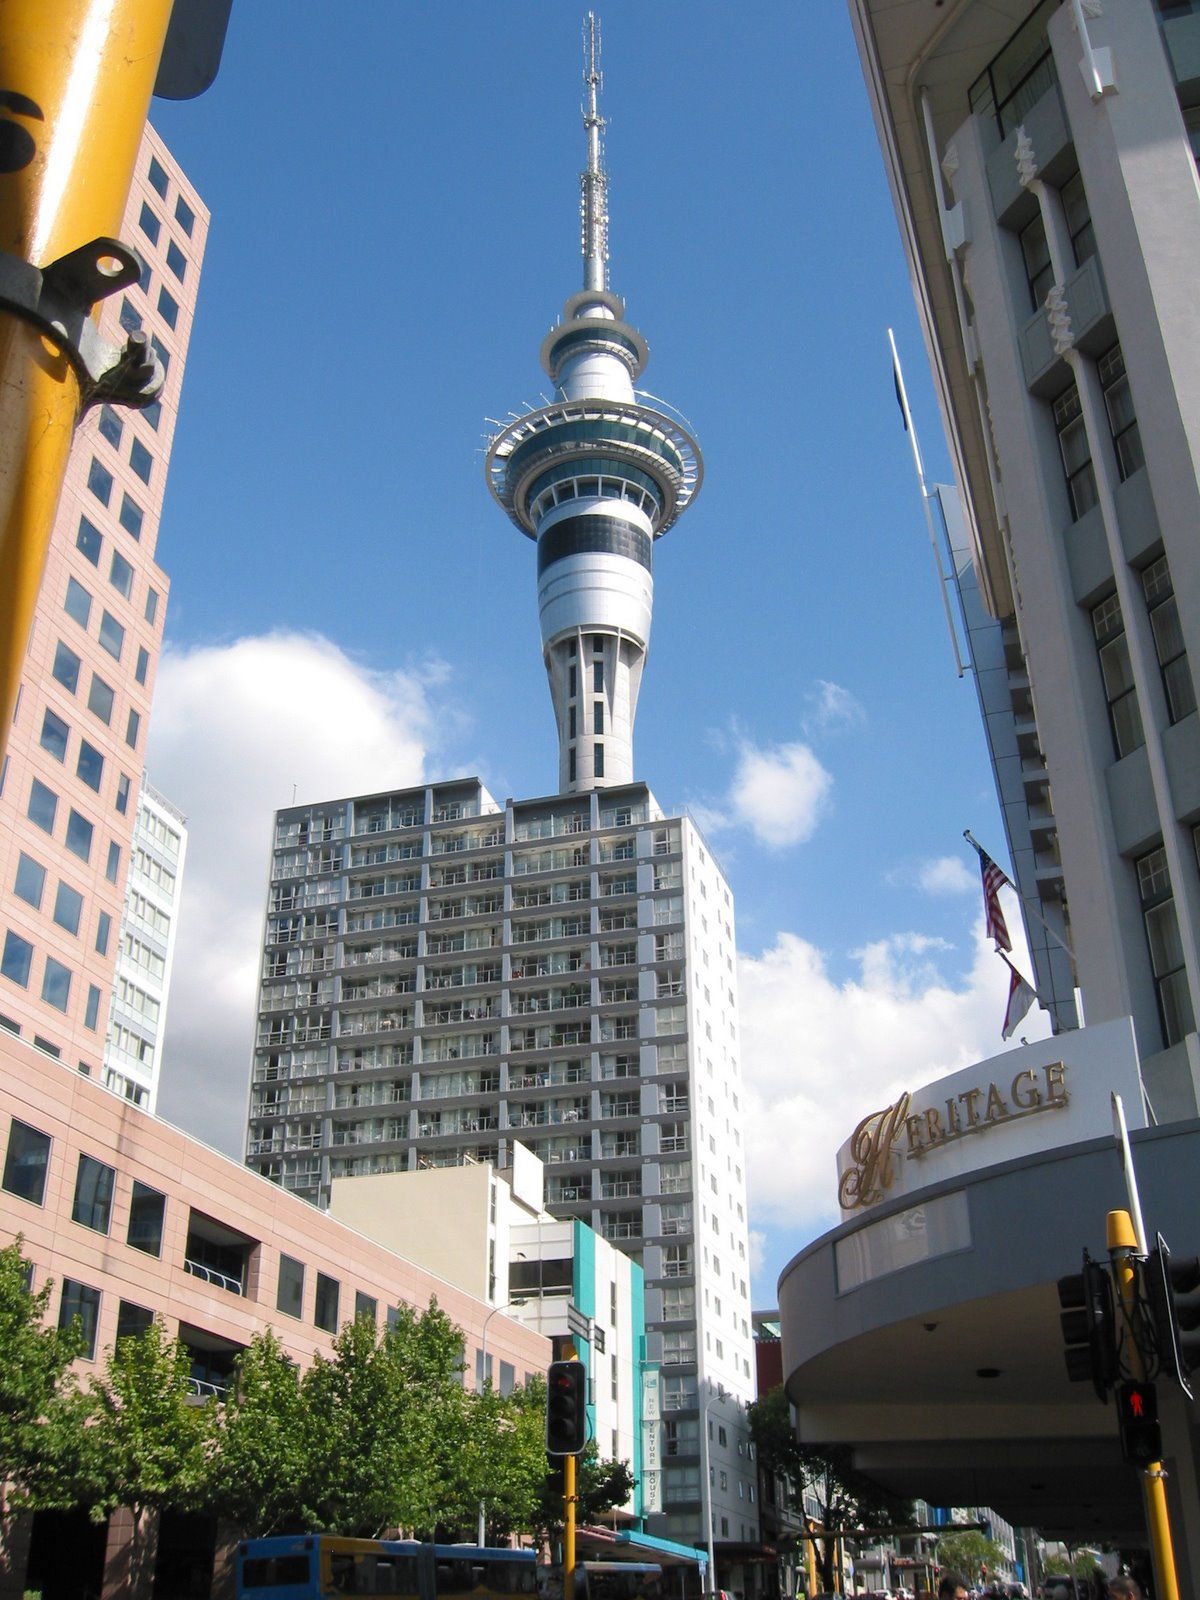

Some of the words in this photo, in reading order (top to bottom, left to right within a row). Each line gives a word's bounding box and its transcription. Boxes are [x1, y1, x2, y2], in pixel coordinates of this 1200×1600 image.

[838, 1060, 1069, 1210] HERITAGE
[648, 1420, 656, 1465] VENTURE
[648, 1471, 656, 1506] HOUSE
